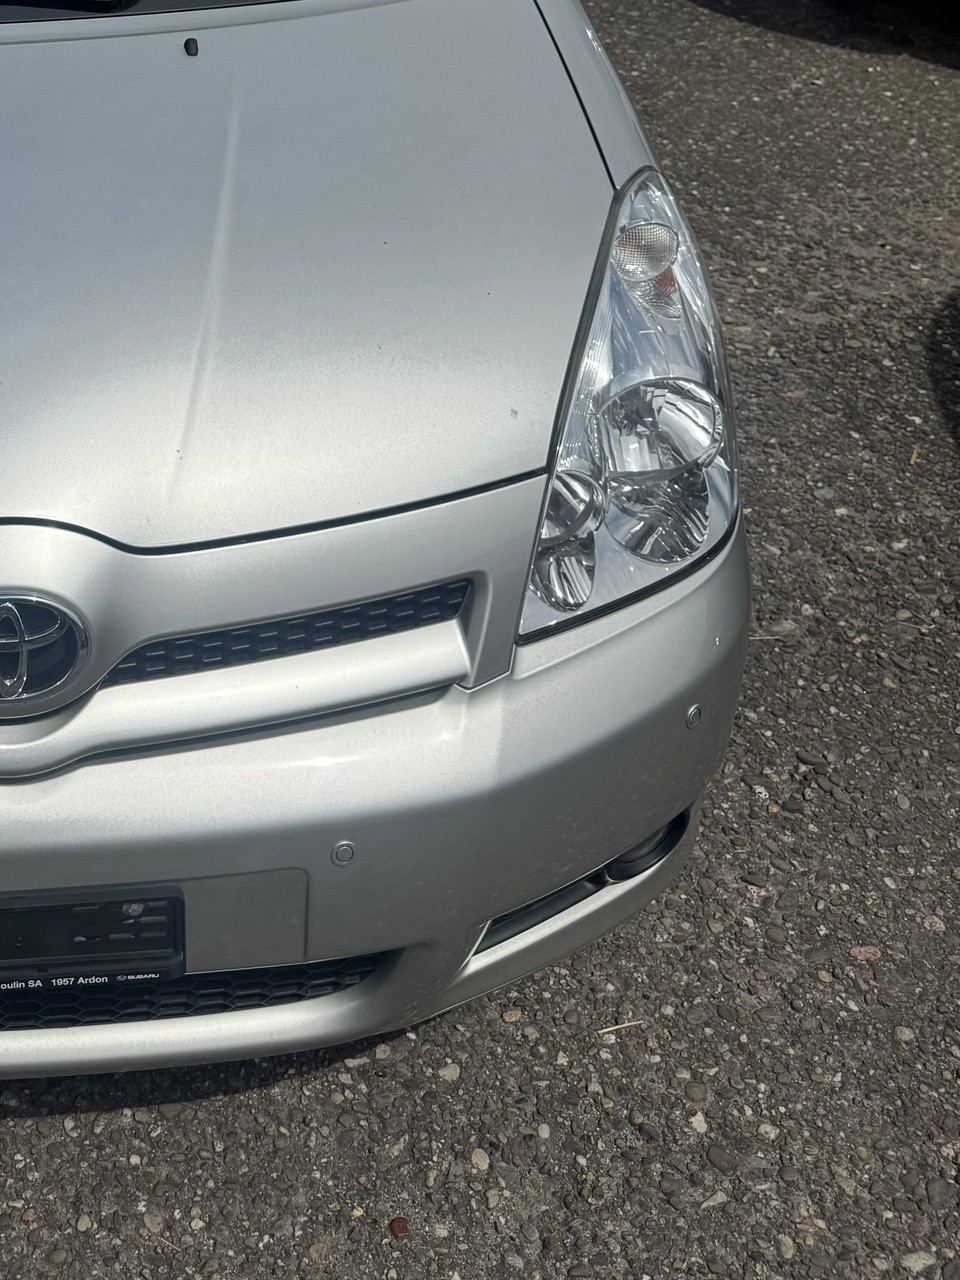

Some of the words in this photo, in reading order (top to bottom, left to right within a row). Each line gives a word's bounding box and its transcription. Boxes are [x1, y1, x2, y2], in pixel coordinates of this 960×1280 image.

[28, 980, 43, 988] SA
[51, 977, 75, 986] 1957
[77, 975, 108, 984] Ardon
